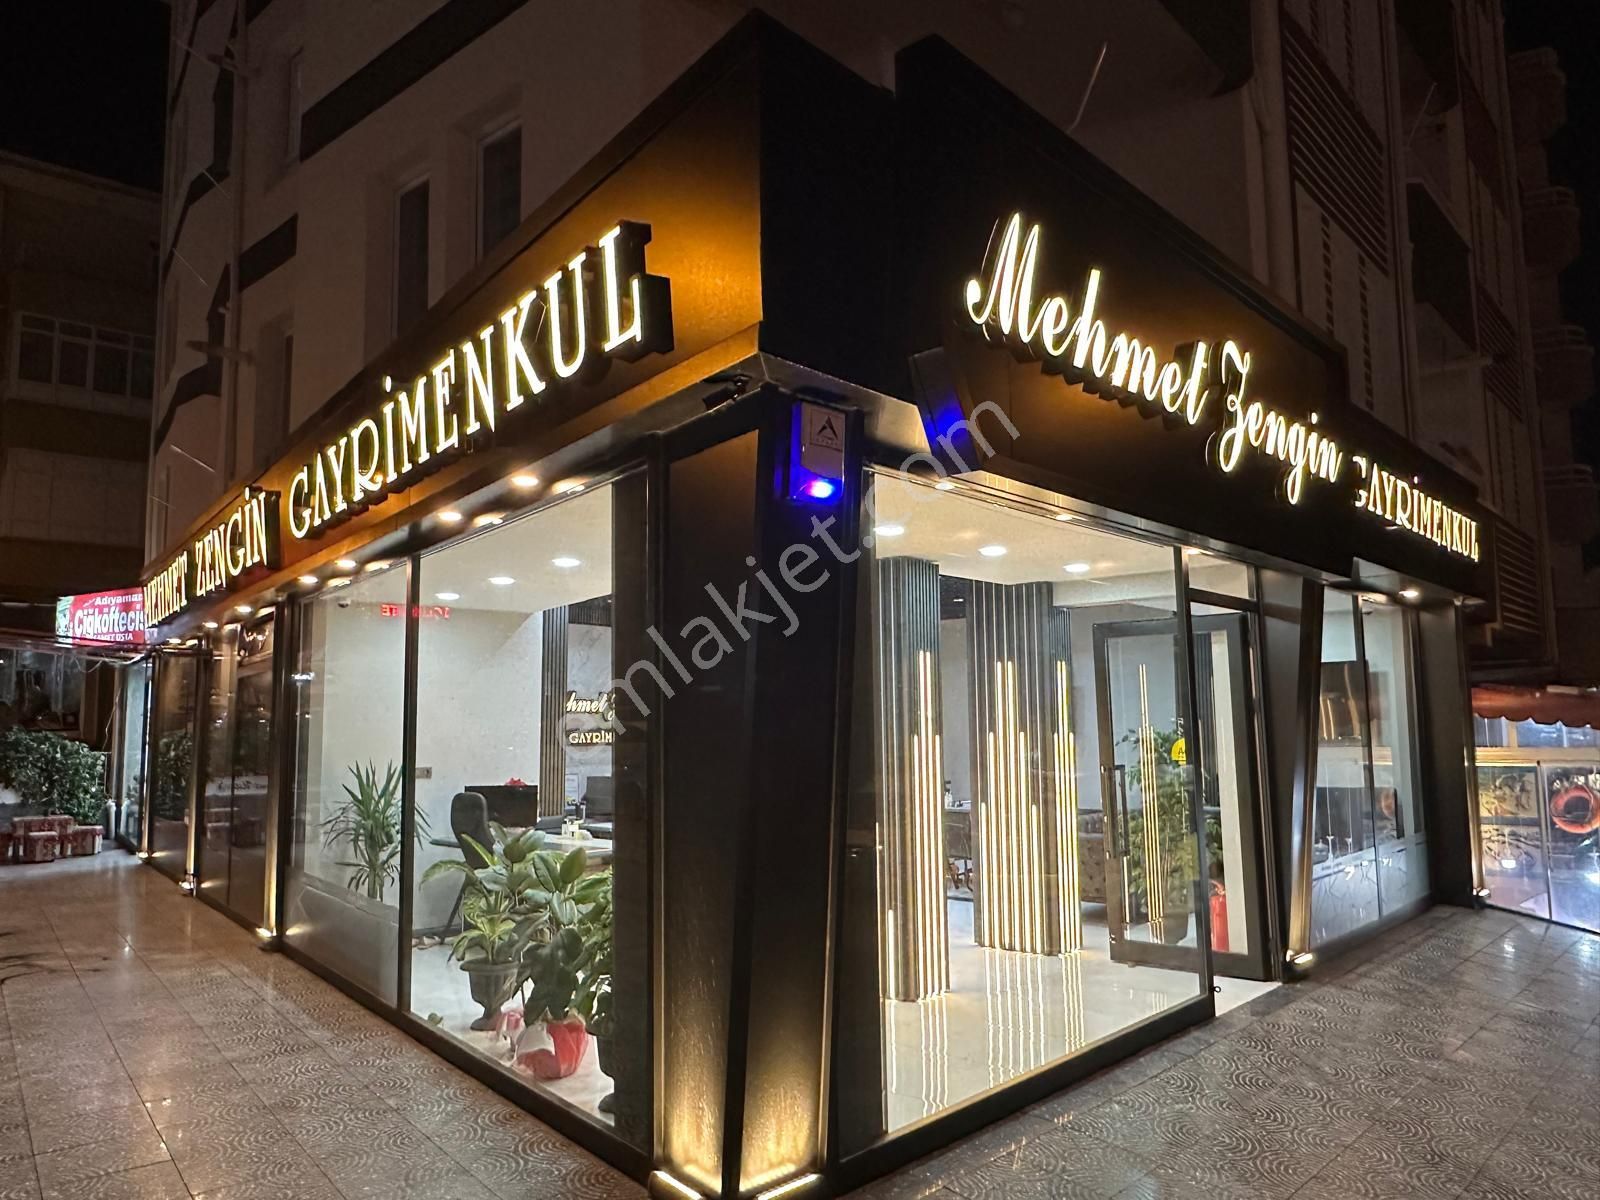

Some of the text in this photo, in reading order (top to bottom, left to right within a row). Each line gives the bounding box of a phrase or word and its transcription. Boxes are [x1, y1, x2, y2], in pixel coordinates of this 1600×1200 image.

[143, 225, 642, 629] MEHMET ZENGİN GAYRİMENKUL
[966, 211, 1342, 505] Mehmet Zengin
